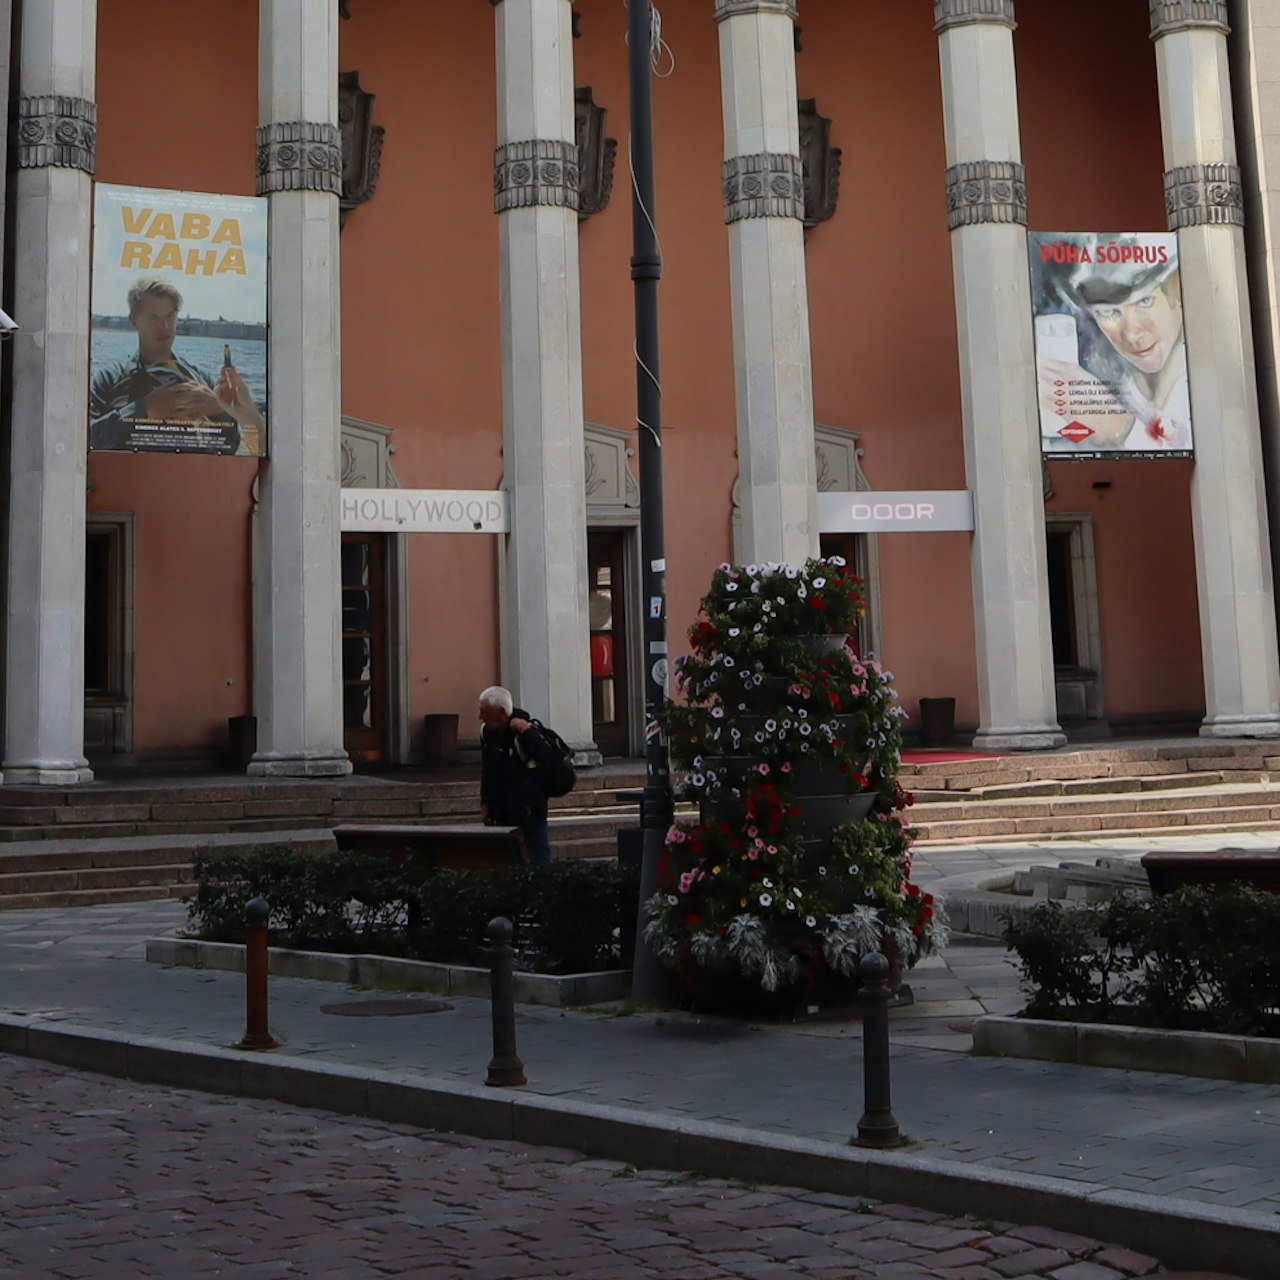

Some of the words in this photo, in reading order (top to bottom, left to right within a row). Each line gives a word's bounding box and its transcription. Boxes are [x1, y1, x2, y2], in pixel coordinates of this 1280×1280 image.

[121, 206, 241, 245] VABA
[120, 241, 247, 276] RAHA
[1040, 240, 1092, 264] PÜHA
[1096, 241, 1168, 264] SÕPRUS
[342, 499, 502, 523] HOLLYWOOD
[852, 503, 935, 521] DOOR
